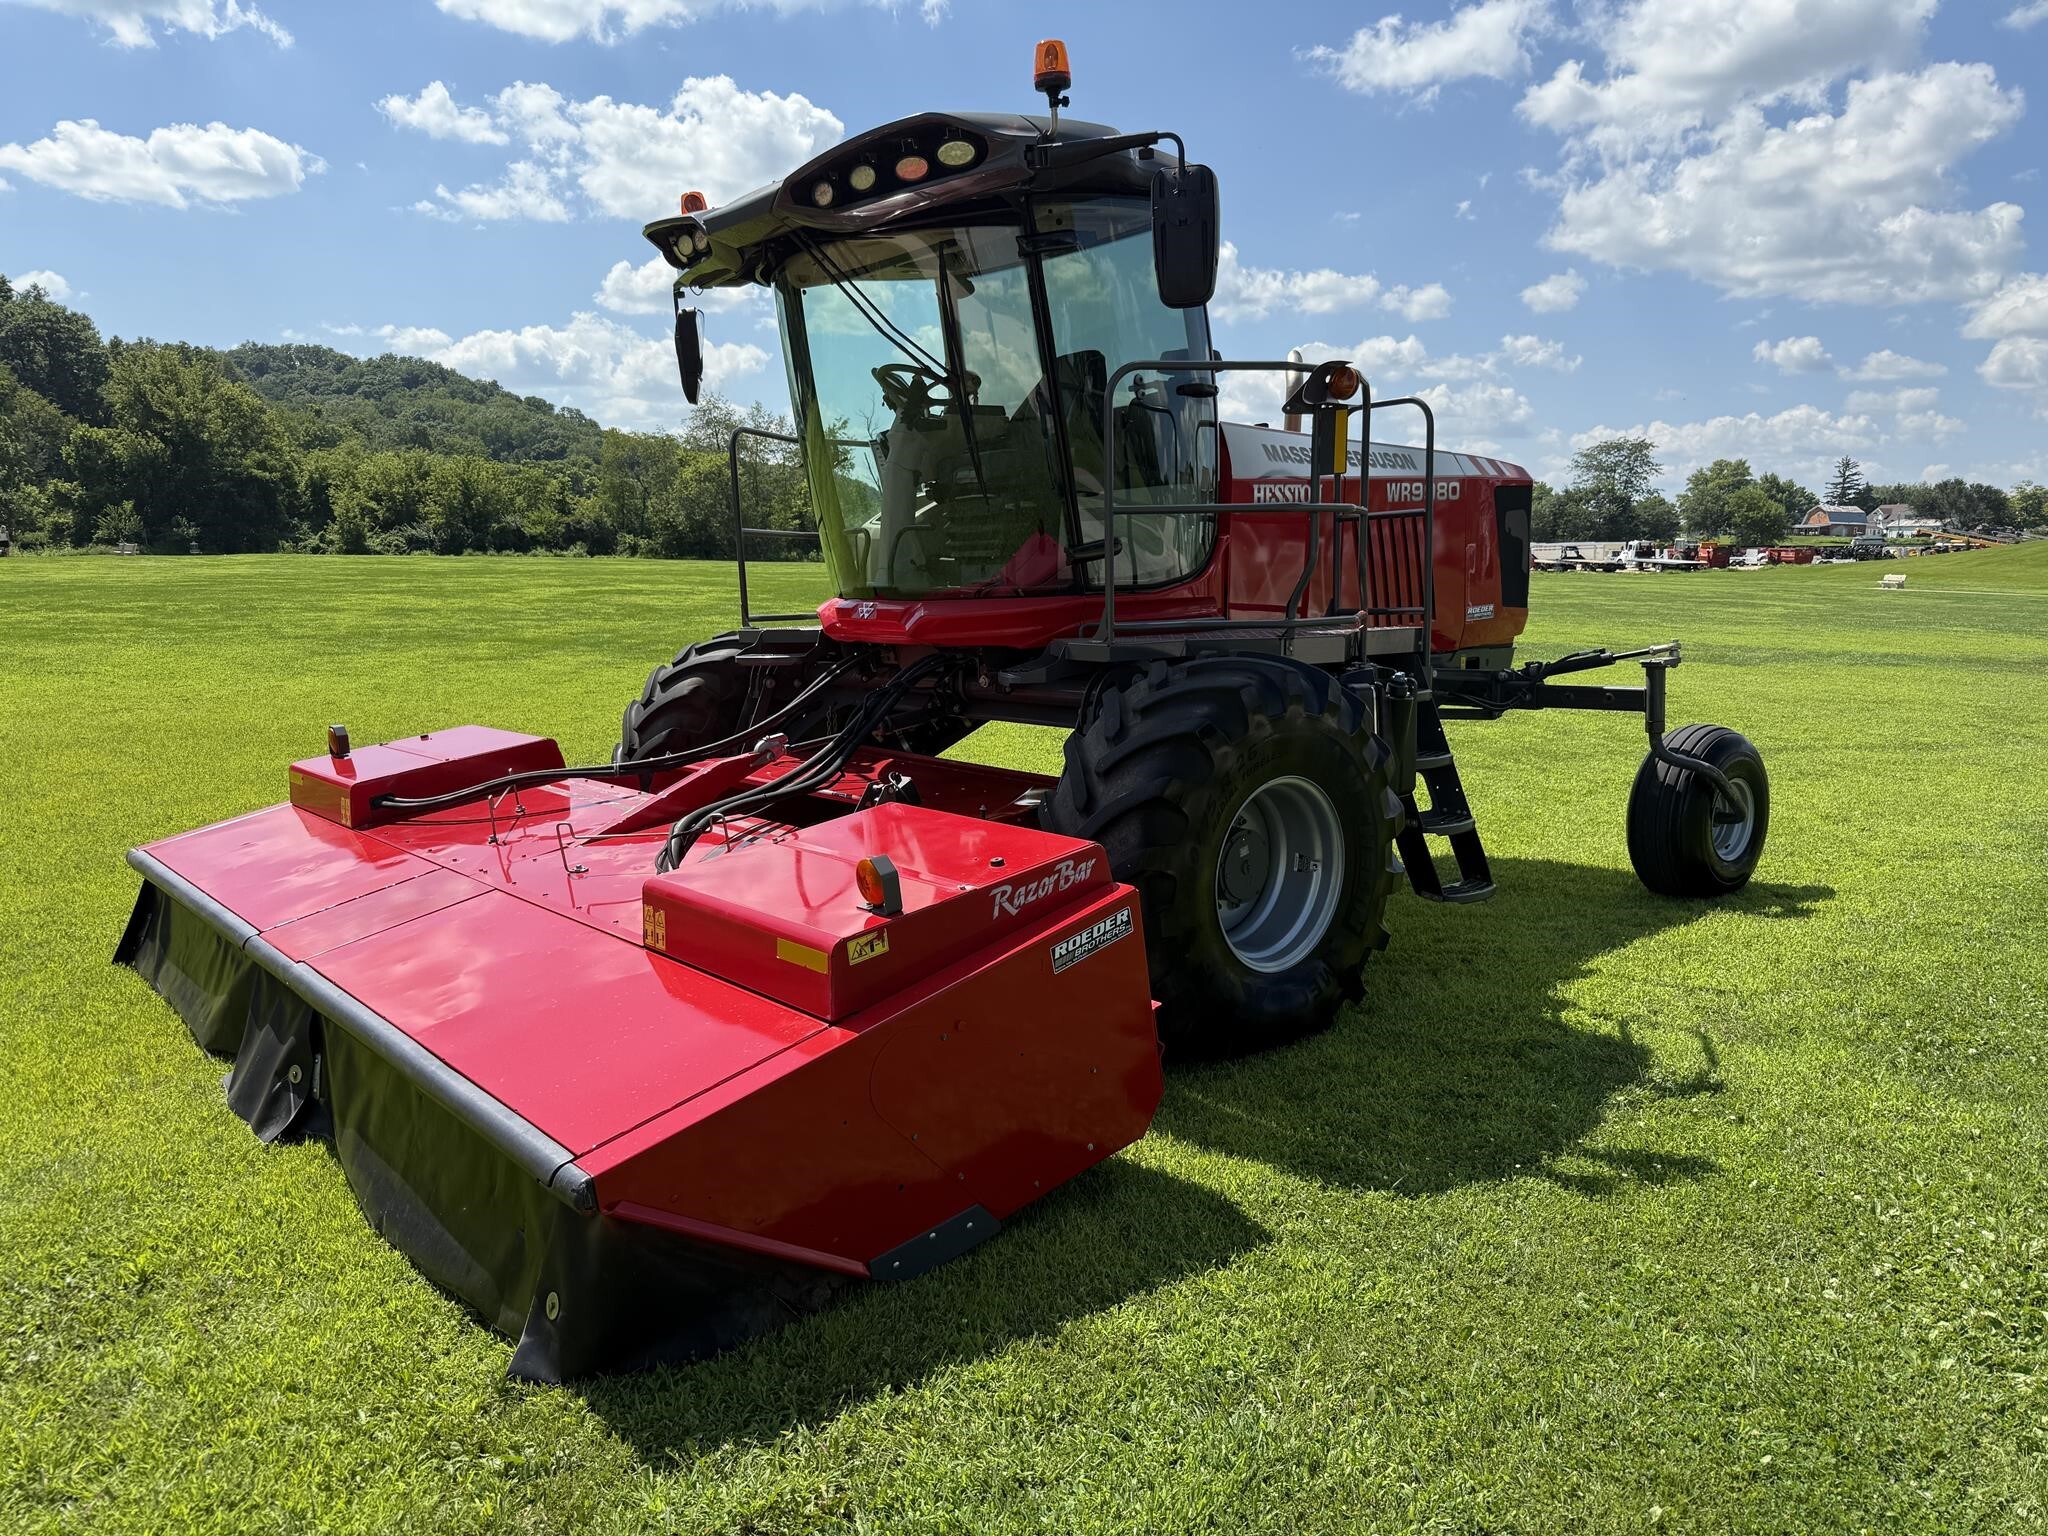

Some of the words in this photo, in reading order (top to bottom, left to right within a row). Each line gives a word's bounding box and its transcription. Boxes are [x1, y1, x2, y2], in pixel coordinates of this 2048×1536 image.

[1261, 443, 1312, 464] MASS
[1253, 484, 1323, 504] HESSTO
[989, 858, 1096, 920] RazorBar
[1054, 909, 1129, 960] ROEDER
[1074, 924, 1127, 957] BROTHERS
